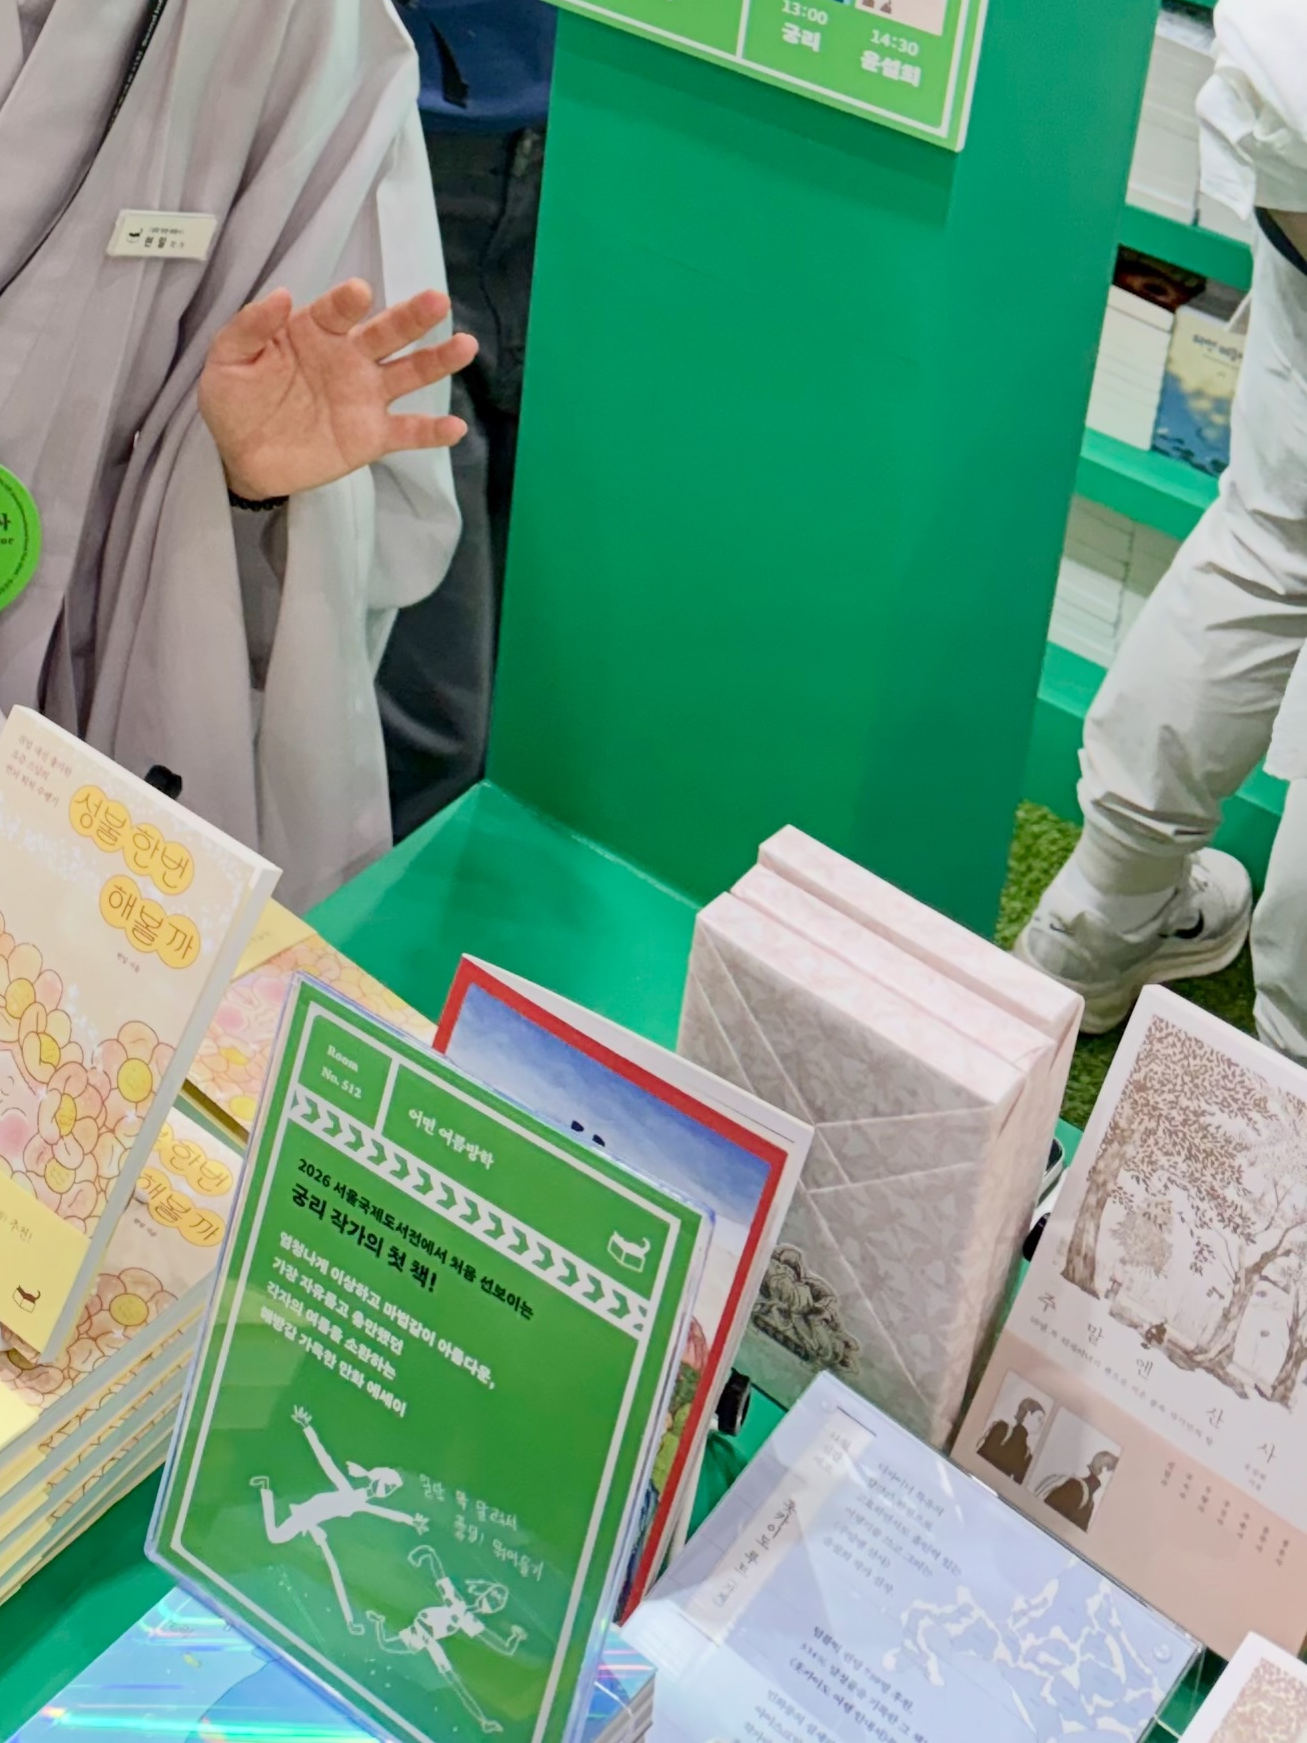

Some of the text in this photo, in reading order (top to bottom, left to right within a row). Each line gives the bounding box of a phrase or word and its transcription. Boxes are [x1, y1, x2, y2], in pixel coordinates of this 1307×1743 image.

[781, 0, 829, 26] 13:00
[781, 21, 821, 52] 궁리
[870, 29, 920, 57] 14:30
[72, 787, 191, 889] 성불 한번
[105, 885, 196, 964] 해볼까
[320, 1065, 363, 1101] No. 512
[325, 1043, 360, 1074] Room
[171, 1140, 230, 1195] 한번
[405, 1105, 495, 1173] 어떤 여름방학
[138, 1179, 221, 1245] 해볼까
[289, 1181, 438, 1294] 궁리 작가의 첫 책!
[296, 1157, 536, 1322] 2026 서울국제도서전에서 처음 선보이는
[263, 1279, 398, 1382] 각자의 여름을 소환하는
[270, 1255, 405, 1356] 가장 자유롭고 충만했던
[276, 1230, 499, 1391] 엄청나게 이상하고 마법같이 아름다운,
[257, 1304, 408, 1419] 해방감 가득한 만화 에세이
